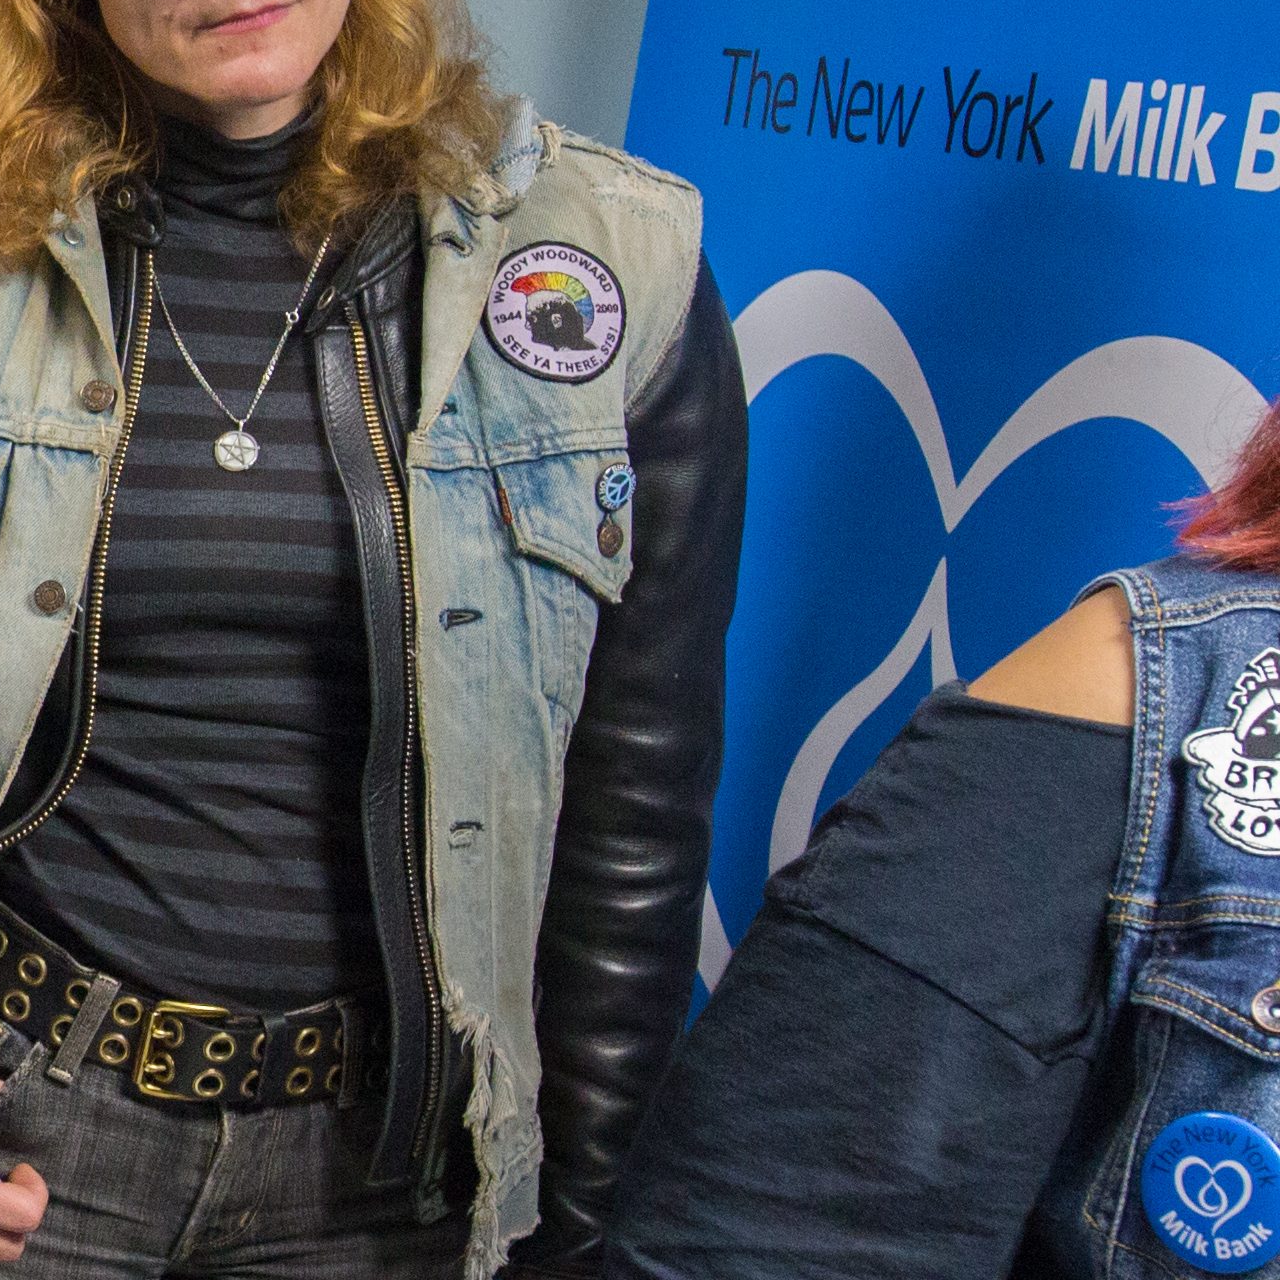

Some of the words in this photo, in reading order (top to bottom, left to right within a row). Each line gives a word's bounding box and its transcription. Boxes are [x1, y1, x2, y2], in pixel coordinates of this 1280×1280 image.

[721, 47, 800, 137] The
[808, 54, 926, 150] New
[941, 64, 1053, 165] York
[1069, 77, 1227, 186] Milk
[493, 257, 530, 304] WOODY
[531, 248, 613, 293] WOODWARD
[493, 310, 523, 325] 1944
[595, 303, 619, 314] 2009
[502, 333, 529, 359] SEE
[533, 354, 551, 371] YA
[1230, 808, 1280, 838] LO
[1151, 1137, 1185, 1173] The
[1183, 1123, 1239, 1147] New
[1242, 1135, 1280, 1188] York
[1159, 1210, 1210, 1257] Milk
[1213, 1221, 1274, 1260] Bank
